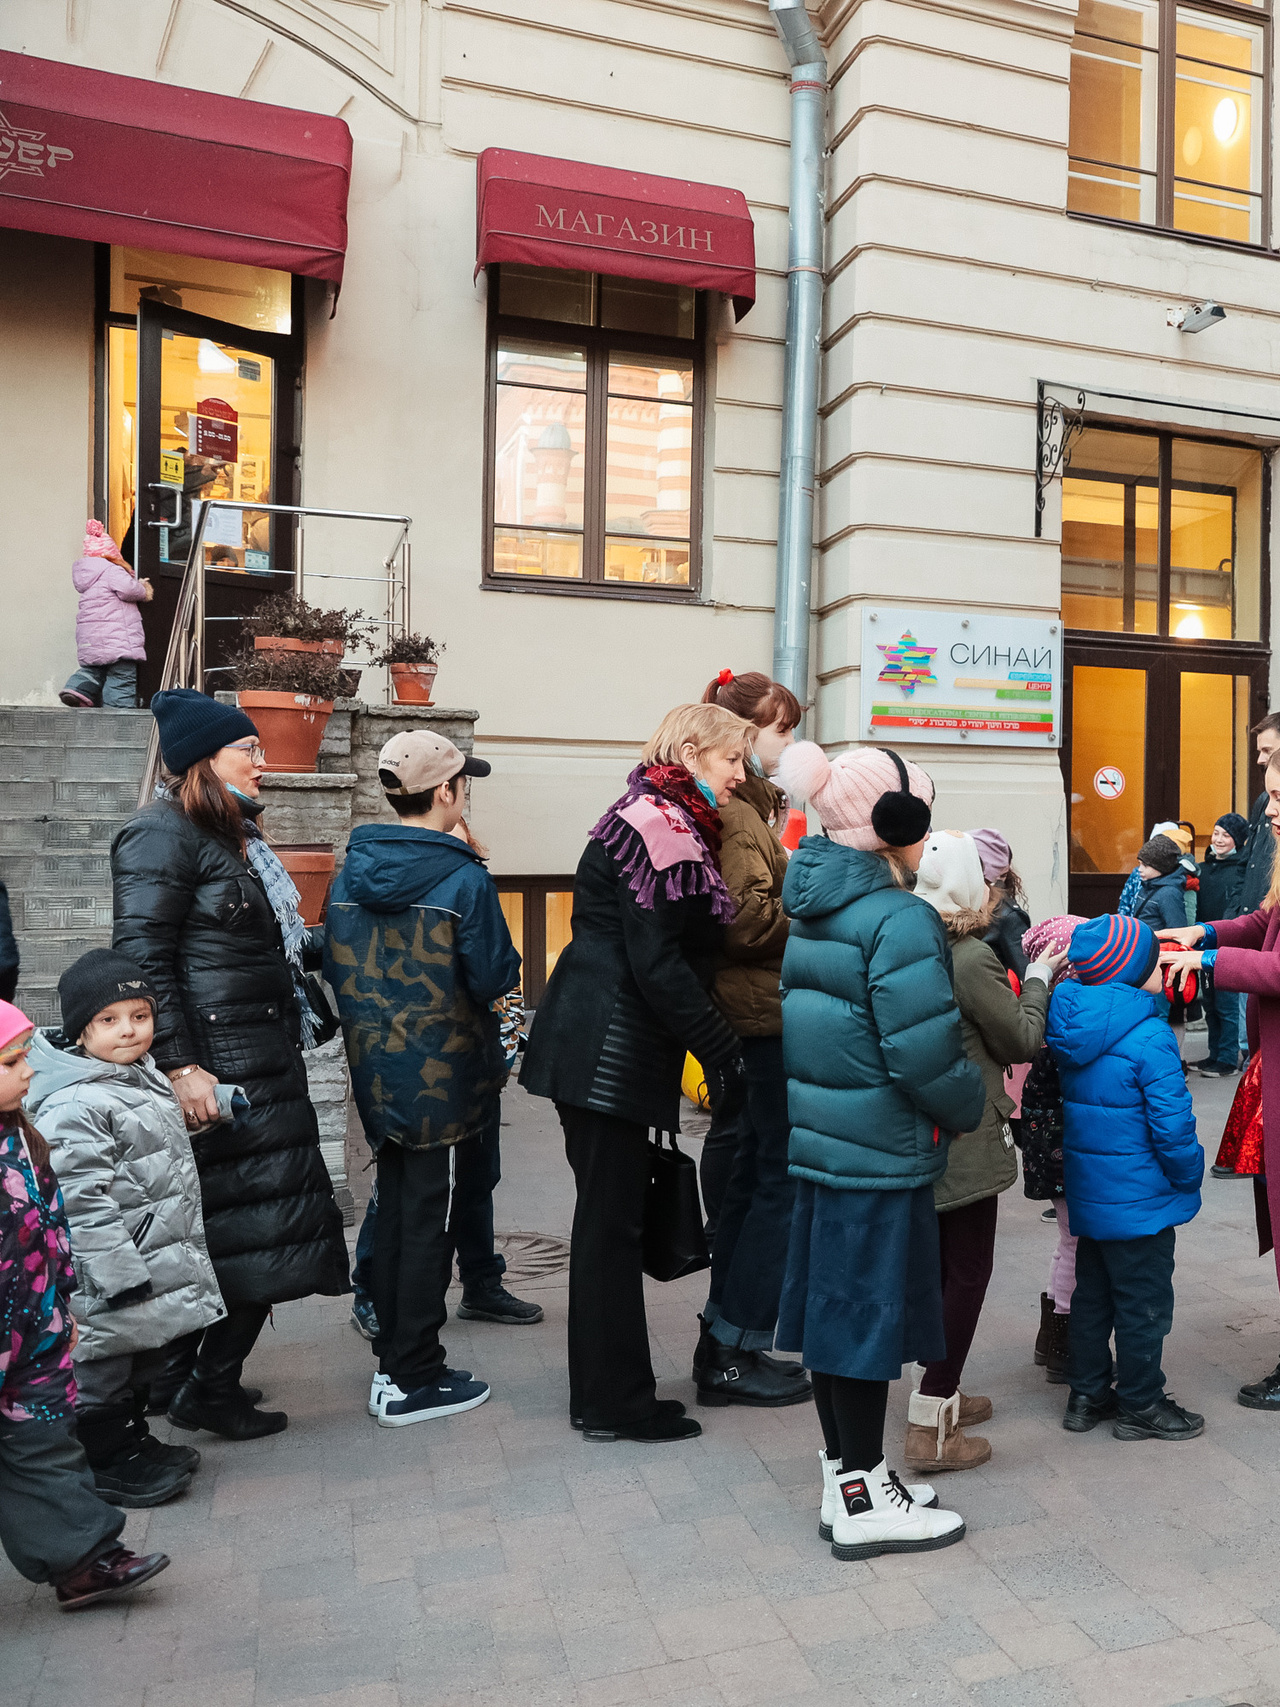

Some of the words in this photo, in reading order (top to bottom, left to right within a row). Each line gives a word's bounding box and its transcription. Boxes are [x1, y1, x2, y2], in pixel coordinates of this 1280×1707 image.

[535, 204, 714, 253] МАГАЗИН
[950, 642, 1052, 670] СИНАЙ
[1027, 682, 1051, 690] ЦЕНТР
[915, 708, 962, 718] EDUCATIONAL
